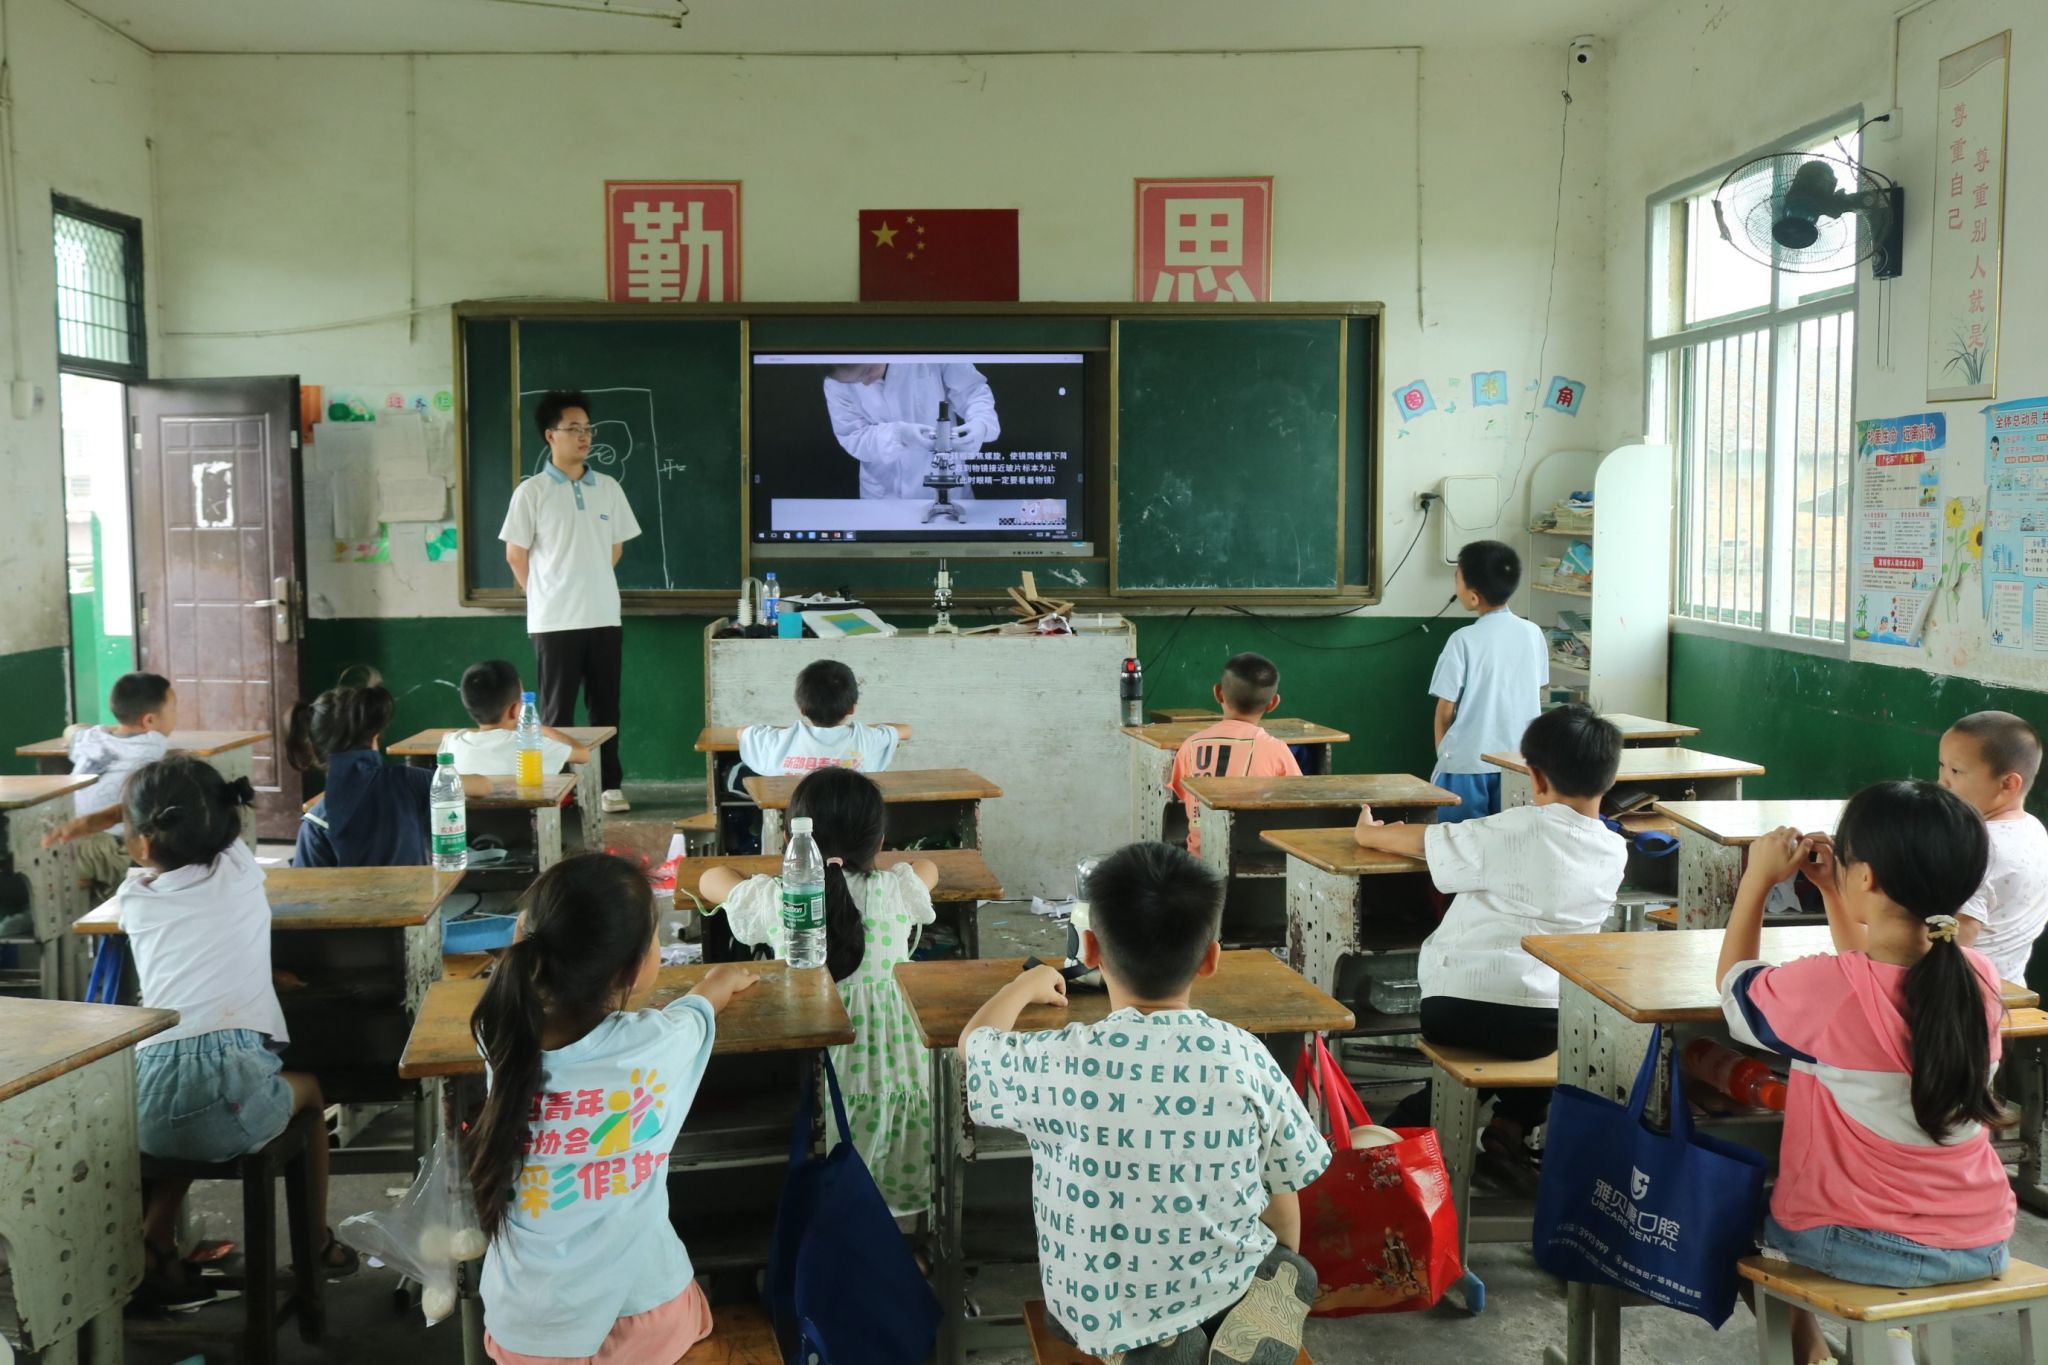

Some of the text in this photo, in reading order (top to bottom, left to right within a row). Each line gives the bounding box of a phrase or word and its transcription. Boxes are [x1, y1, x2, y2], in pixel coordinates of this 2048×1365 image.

[1949, 102, 1968, 230] 尊重自己
[623, 202, 723, 302] 勤
[1152, 198, 1256, 302] 思
[1968, 147, 1990, 348] 尊重别人就是
[1556, 386, 1573, 407] 角
[1995, 411, 2038, 428] 全体总动员
[1033, 1117, 1256, 1150] HOUSEKITSUNÉ
[1629, 1226, 1676, 1252] DENTAL
